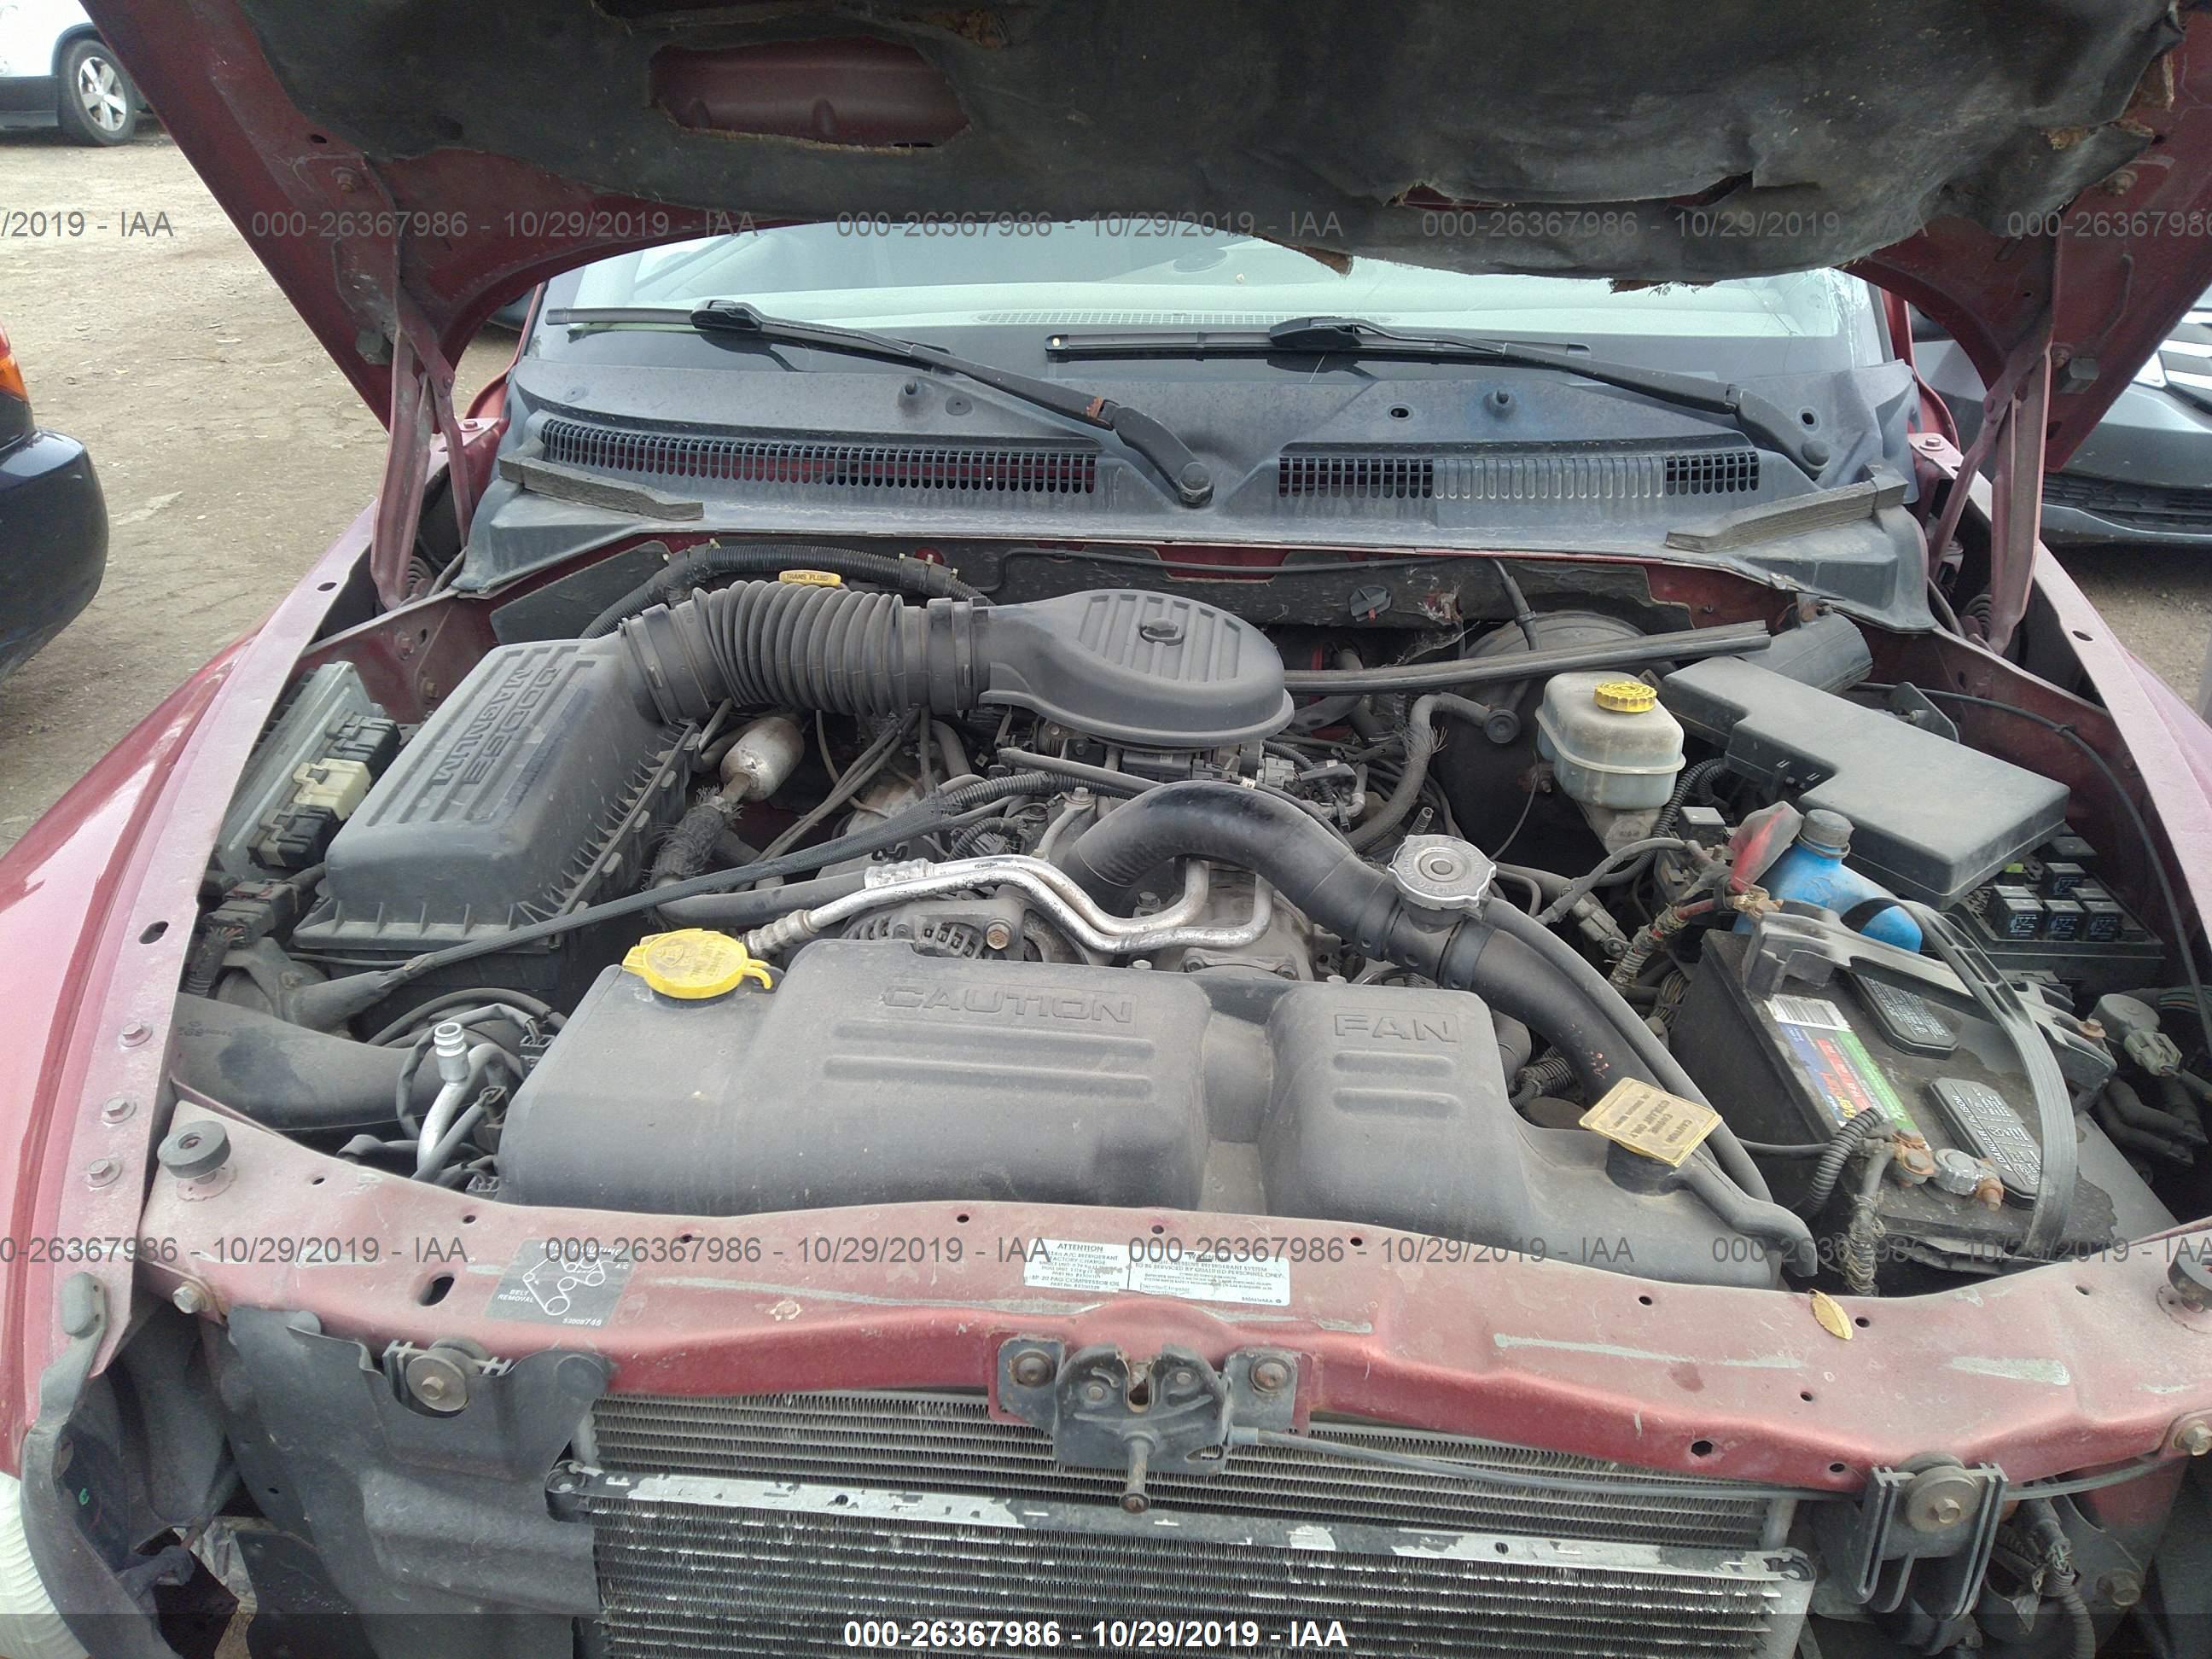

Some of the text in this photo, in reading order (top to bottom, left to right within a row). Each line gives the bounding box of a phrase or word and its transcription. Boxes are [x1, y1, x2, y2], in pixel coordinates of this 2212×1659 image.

[430, 669, 533, 785] MAGNUM
[463, 668, 561, 784] DODGE
[882, 984, 1458, 1043] CAUTION FAN
[1952, 1094, 1979, 1125] POISON
[1976, 1130, 2007, 1164] DANGER
[1057, 1243, 1103, 1253] ATTENTION
[498, 1295, 534, 1303] REMOVAL
